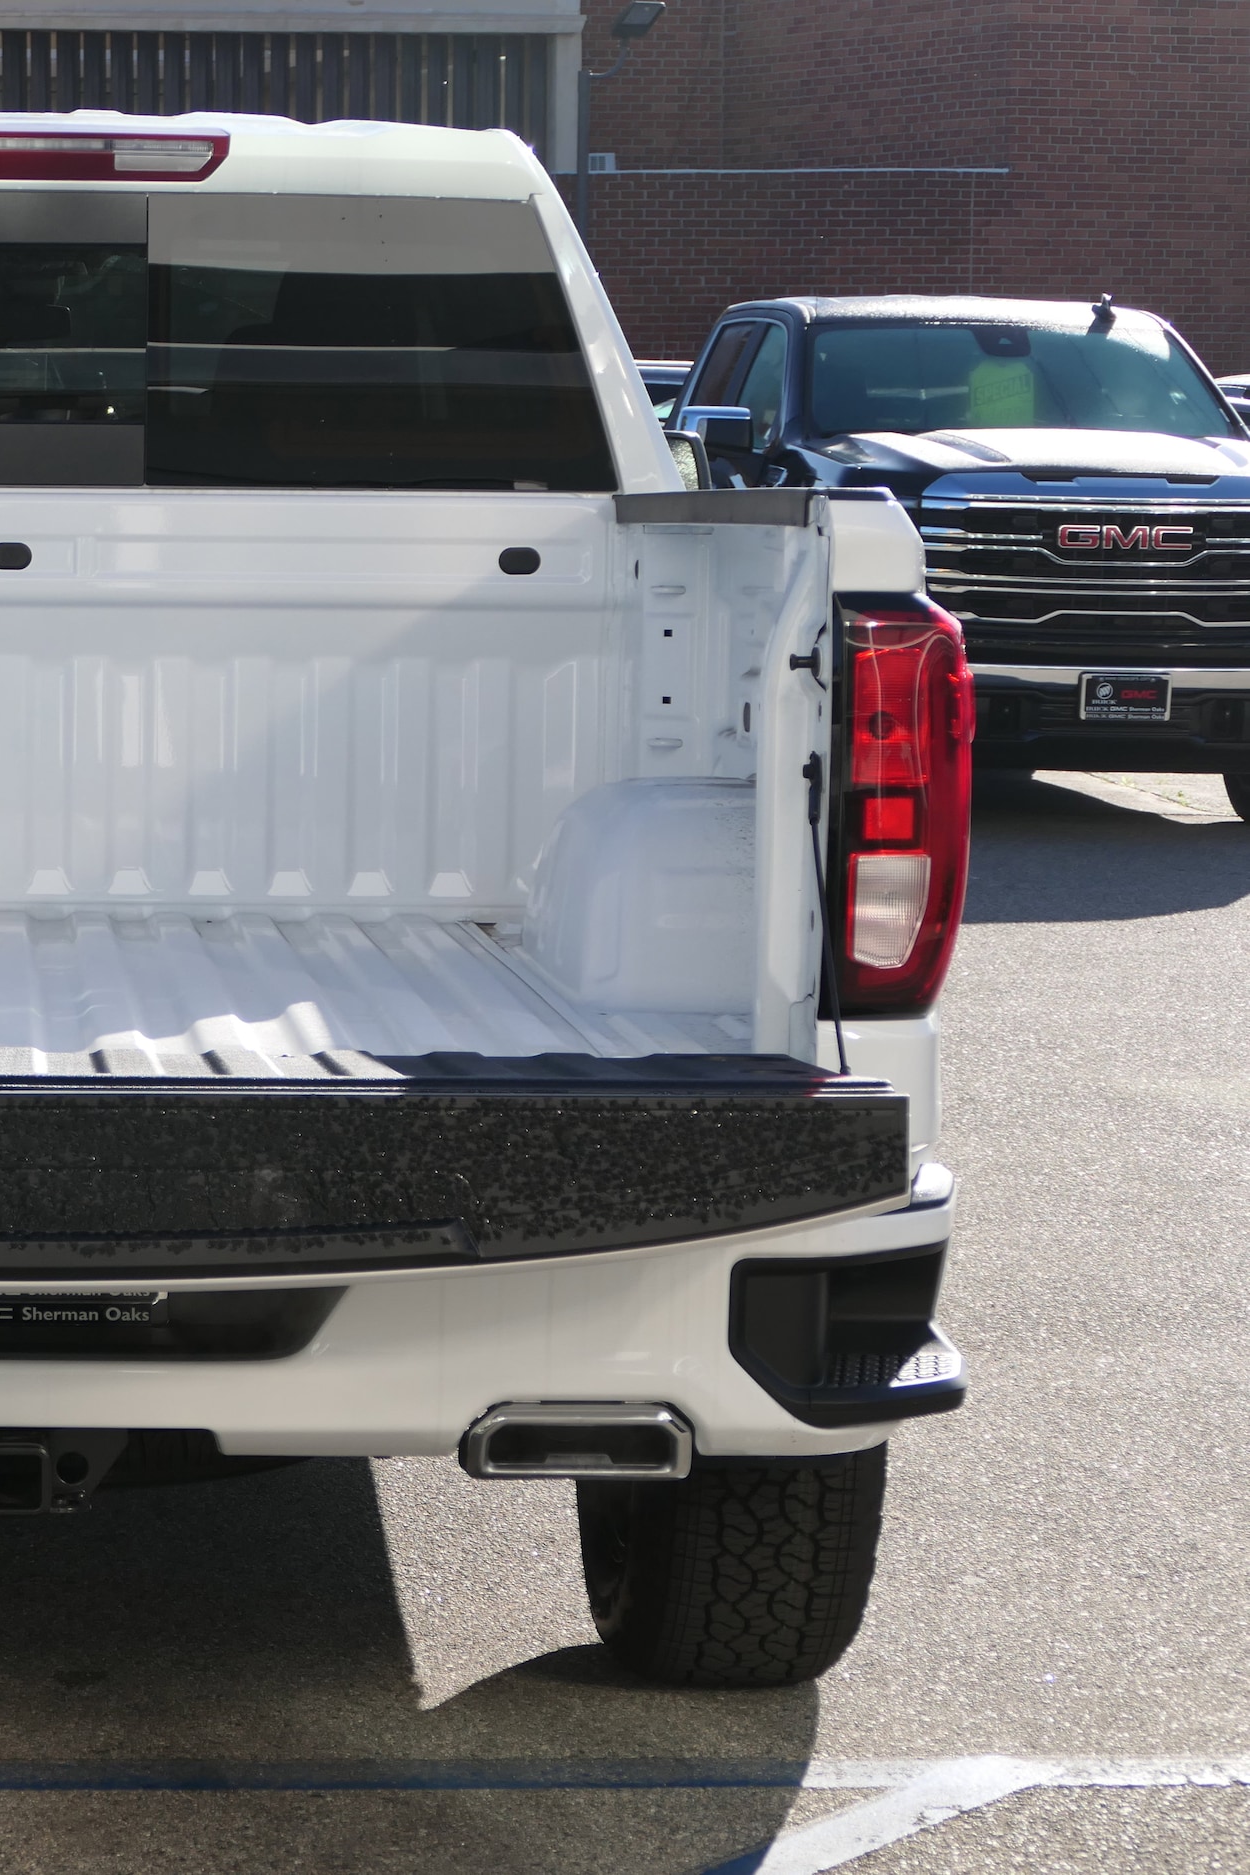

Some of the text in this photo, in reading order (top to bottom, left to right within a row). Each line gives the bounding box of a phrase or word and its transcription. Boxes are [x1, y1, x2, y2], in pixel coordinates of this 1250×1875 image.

[1058, 524, 1194, 550] GMC
[1120, 690, 1158, 699] GMC
[22, 1307, 99, 1321] Sherman
[105, 1307, 150, 1321] Oaks
